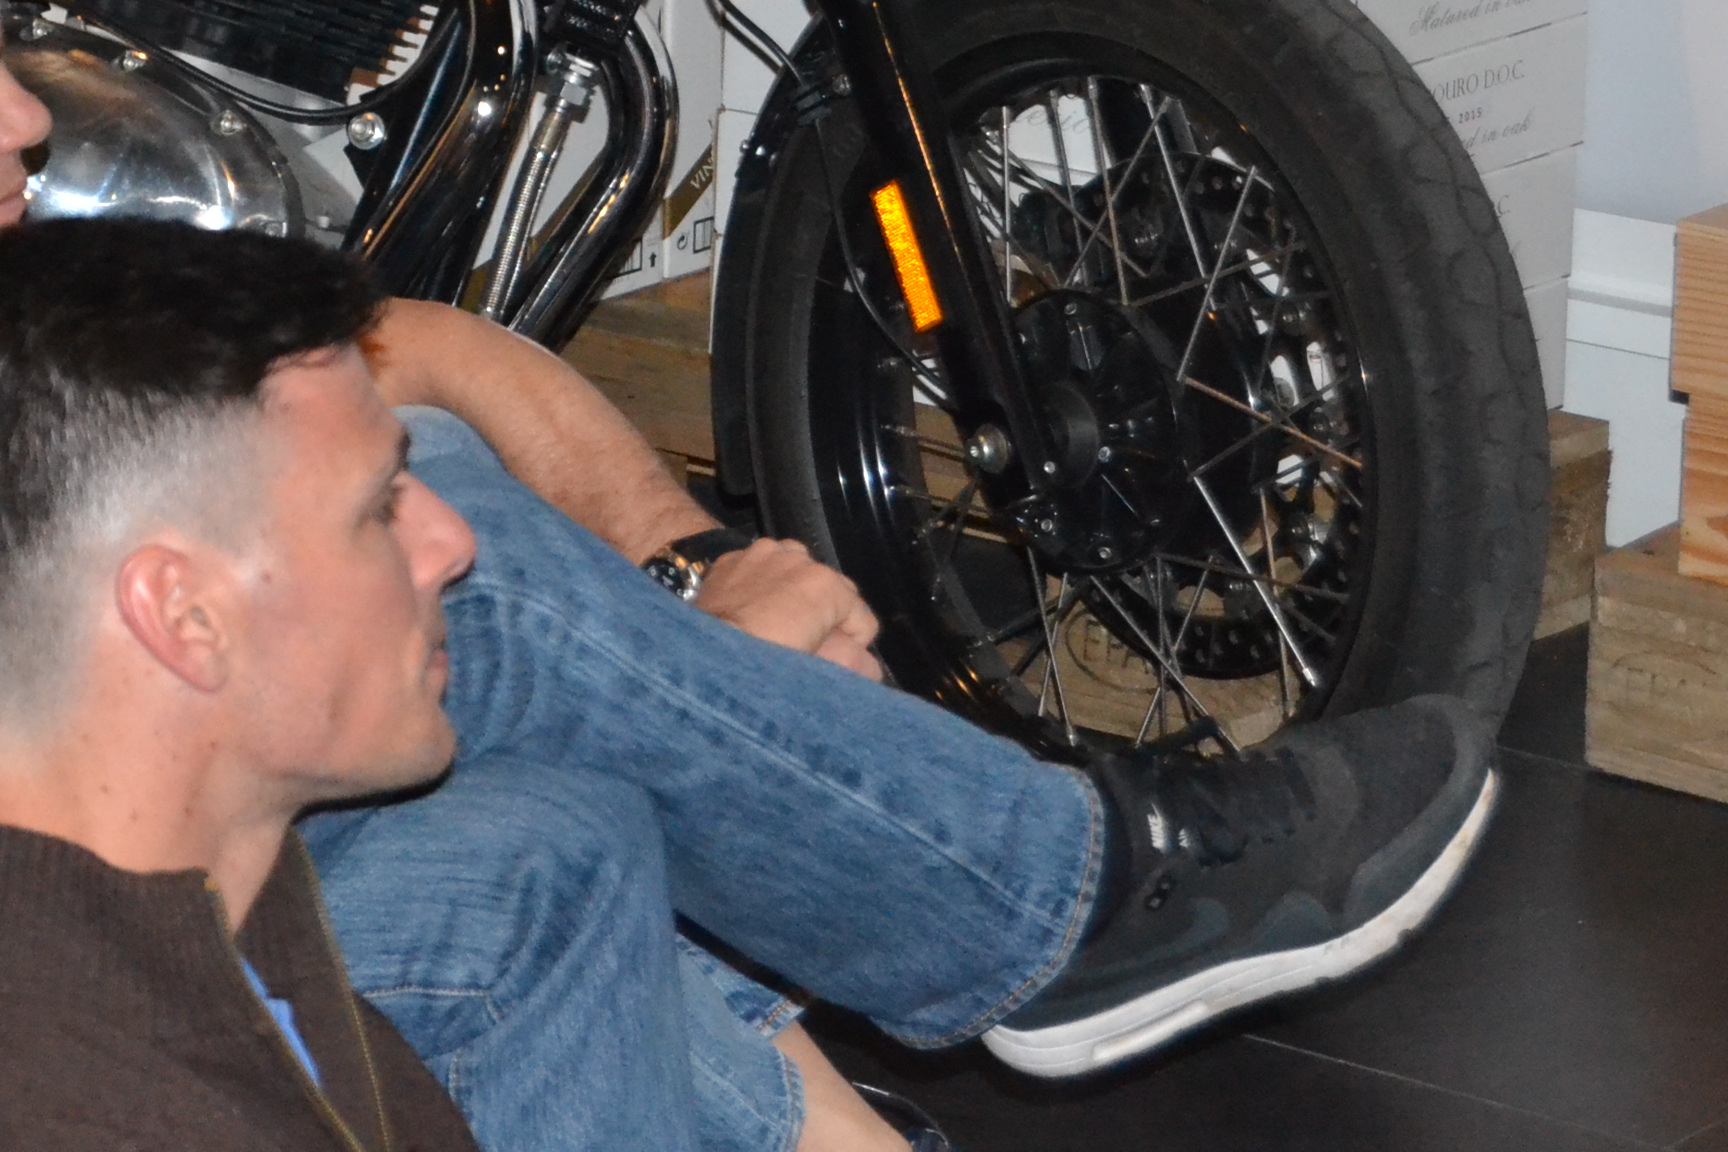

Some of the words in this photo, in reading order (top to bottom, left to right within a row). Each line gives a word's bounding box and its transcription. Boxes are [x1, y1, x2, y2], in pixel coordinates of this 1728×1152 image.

[1484, 1, 1500, 15] in
[1433, 73, 1479, 102] OURO
[1458, 107, 1483, 124] 2015
[1482, 129, 1498, 144] in
[1502, 106, 1536, 138] oak
[1147, 812, 1166, 849] NIKE
